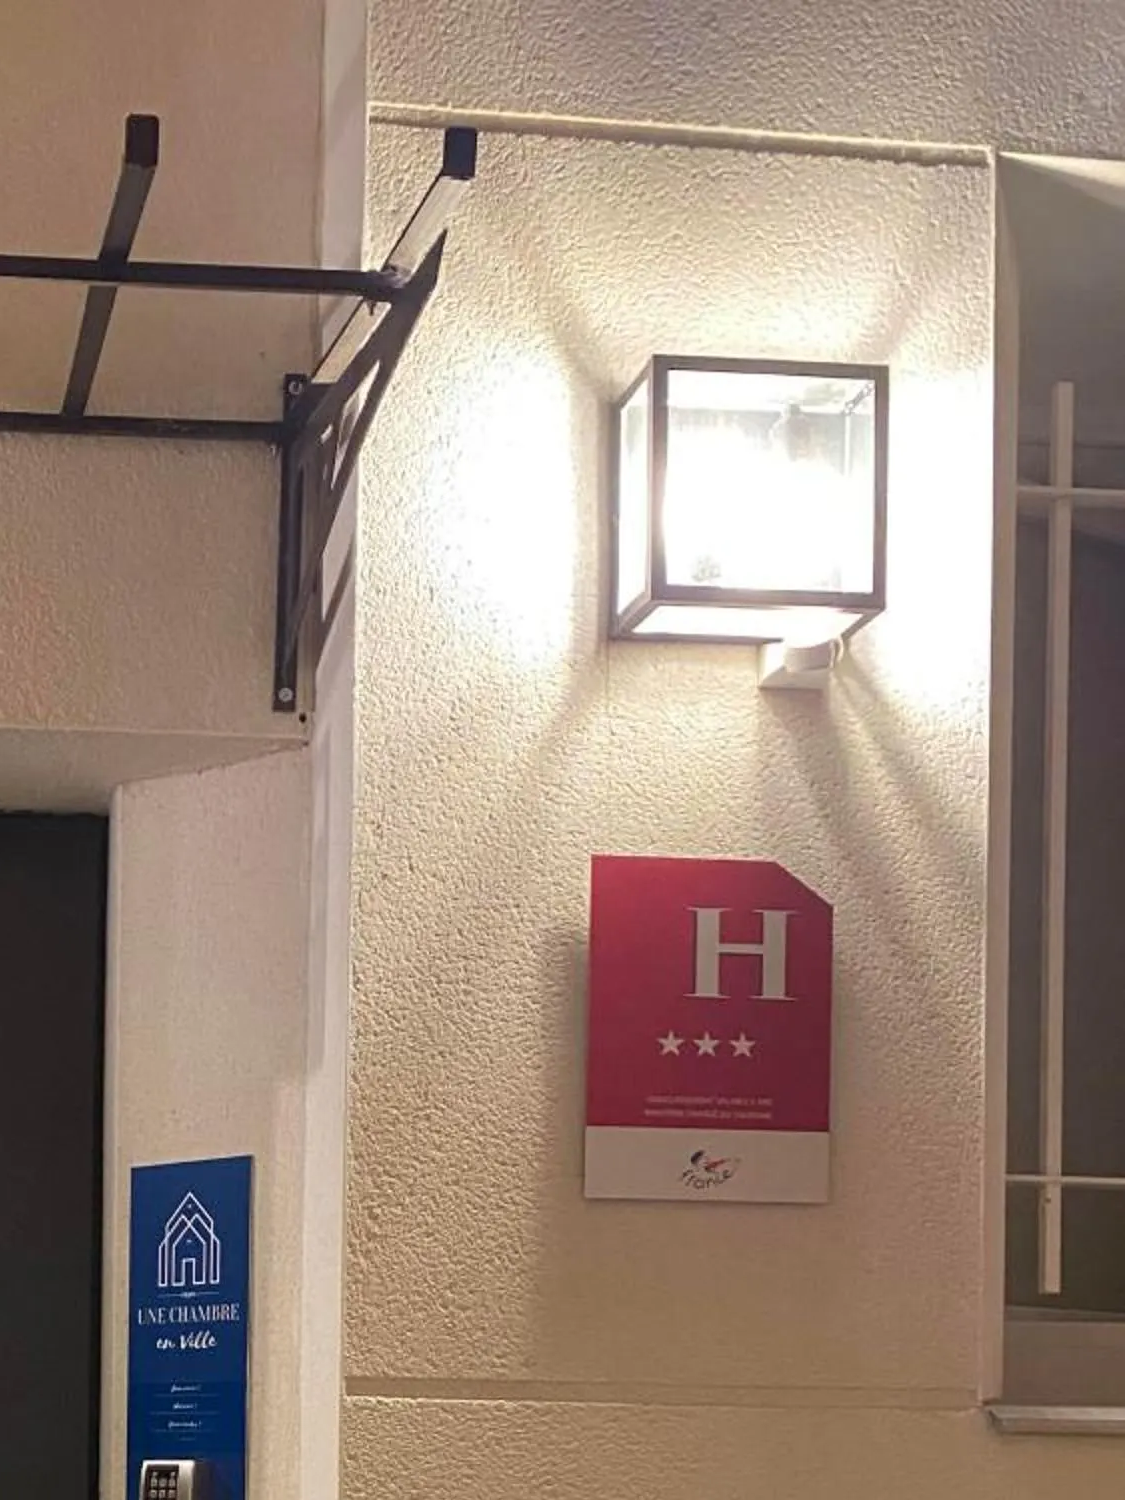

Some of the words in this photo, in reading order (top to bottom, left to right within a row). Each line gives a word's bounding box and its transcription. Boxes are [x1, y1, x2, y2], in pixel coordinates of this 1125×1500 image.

[683, 906, 801, 1001] H
[138, 1307, 166, 1325] UNE
[169, 1303, 240, 1324] CHAMBRE
[156, 1337, 175, 1350] en
